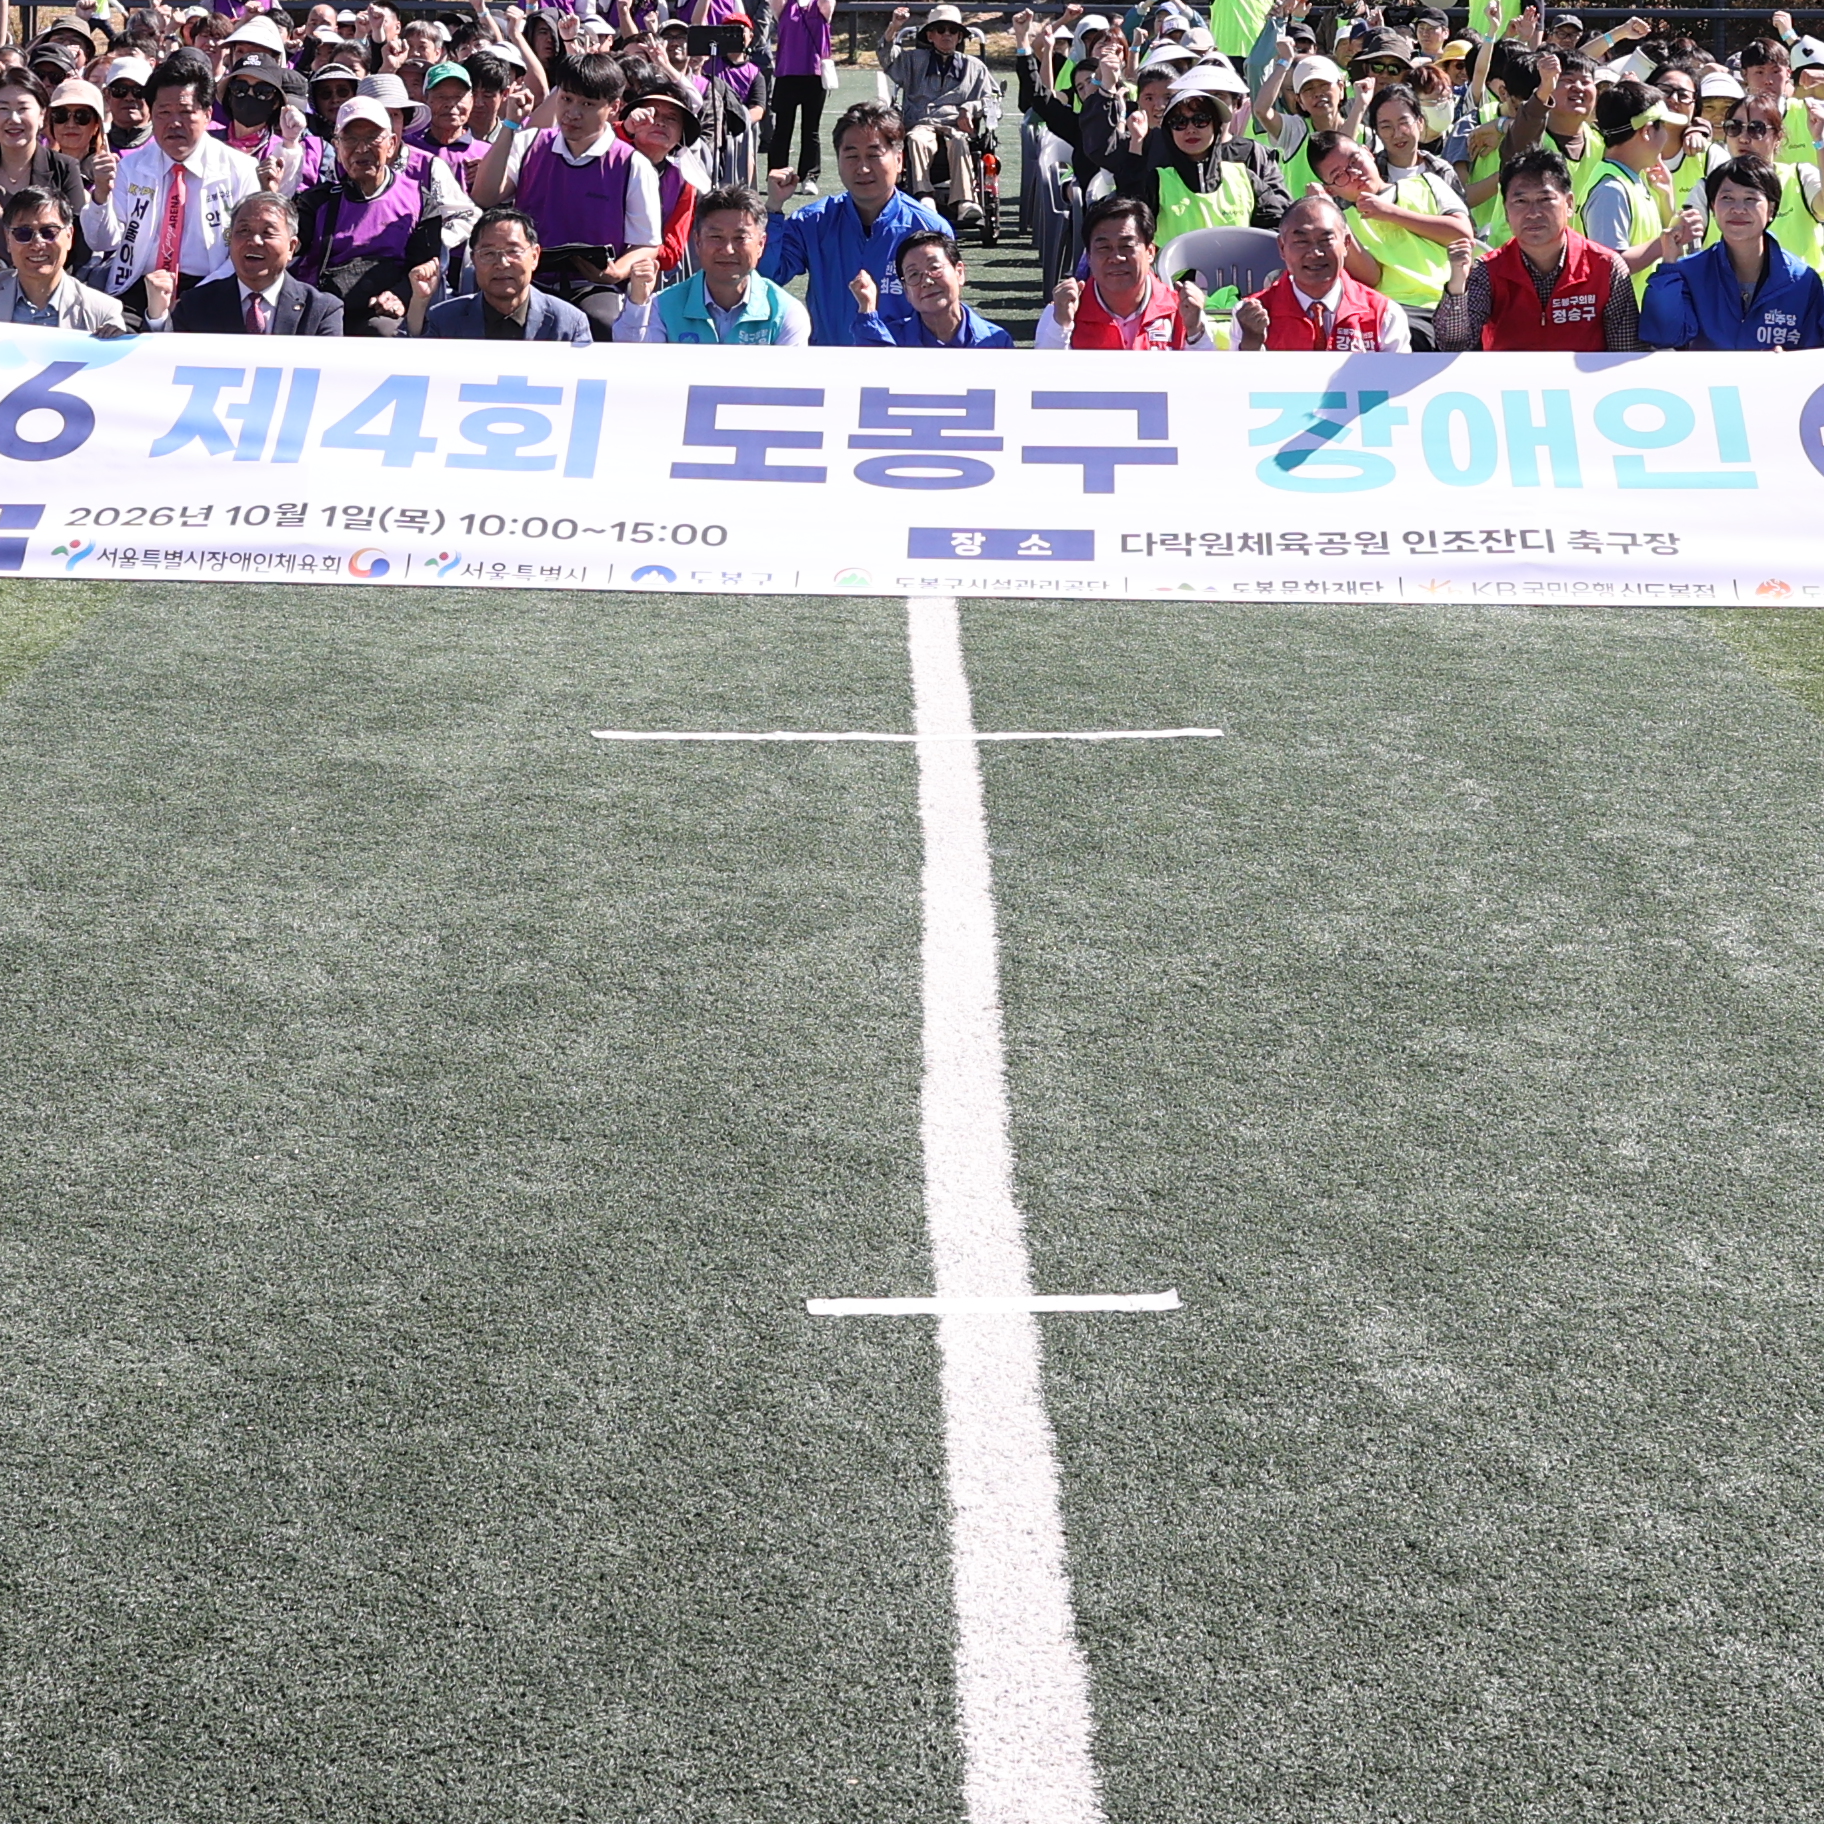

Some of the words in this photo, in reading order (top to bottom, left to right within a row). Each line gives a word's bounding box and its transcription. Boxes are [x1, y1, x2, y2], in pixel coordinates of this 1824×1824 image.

[169, 193, 180, 229] ARENA
[1552, 294, 1596, 307] 도봉구의원
[1552, 306, 1597, 324] 정승구
[1764, 312, 1797, 327] 민주당
[1756, 326, 1801, 345] 이영숙
[148, 365, 607, 479] 제4회
[670, 385, 1179, 495] 도봉구
[1247, 385, 1759, 494] 장애인
[64, 503, 215, 529] 2026년
[225, 501, 308, 529] 10월
[319, 503, 444, 536] 1일(목)
[458, 513, 729, 547] 10:00~15:00
[950, 532, 1053, 557] 장소
[1120, 530, 1390, 557] 다락원체육공원
[1402, 528, 1555, 555] 인조잔디
[1566, 529, 1680, 557] 축구장
[96, 546, 342, 575] 서울특별시장애인체육회
[460, 560, 588, 583] 서울특별시
[895, 577, 1111, 593] 도봉구시설관리공단
[1231, 578, 1385, 596] 도봉문화재단
[1620, 581, 1717, 599] 신도봉점
